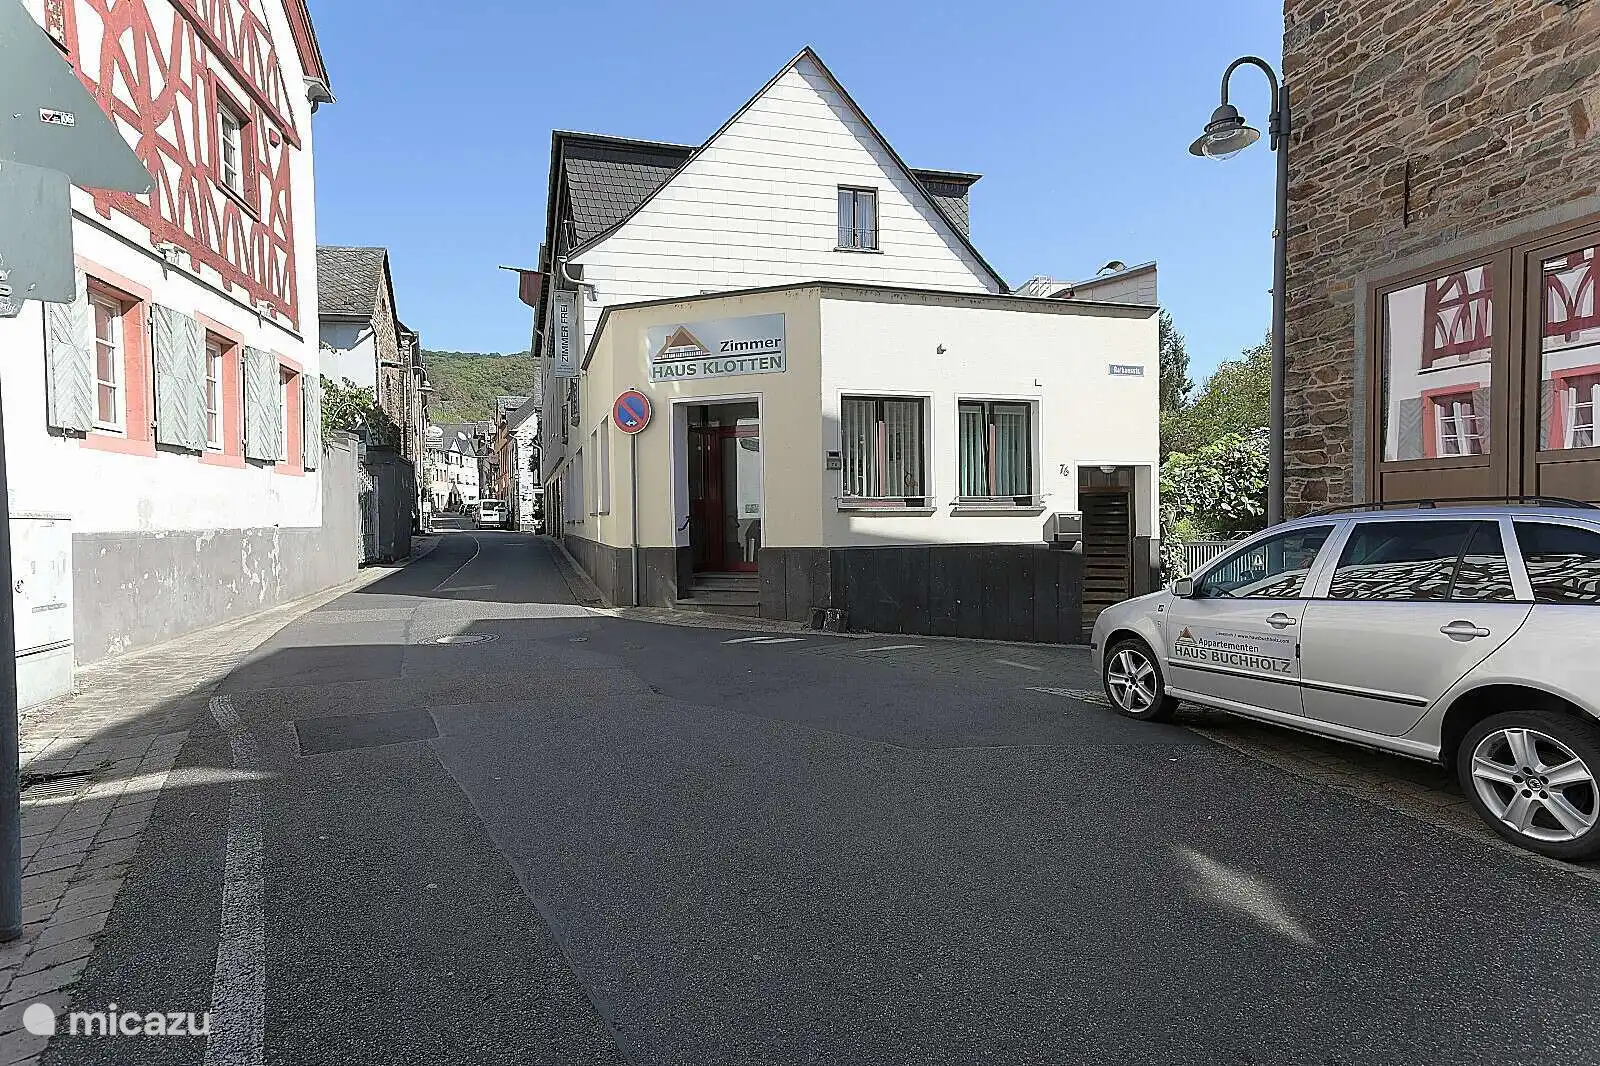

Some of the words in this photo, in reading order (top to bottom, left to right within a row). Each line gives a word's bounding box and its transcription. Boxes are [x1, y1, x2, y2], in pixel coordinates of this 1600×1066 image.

[561, 325, 569, 363] ZIMMER
[720, 338, 782, 353] Zimmer
[652, 363, 697, 379] HAUS
[703, 356, 782, 375] KLOTTEN
[1060, 463, 1069, 476] 76
[1198, 637, 1259, 653] Appartementen
[1174, 645, 1207, 660] HAUS
[1211, 651, 1292, 674] BUCHHOLZ
